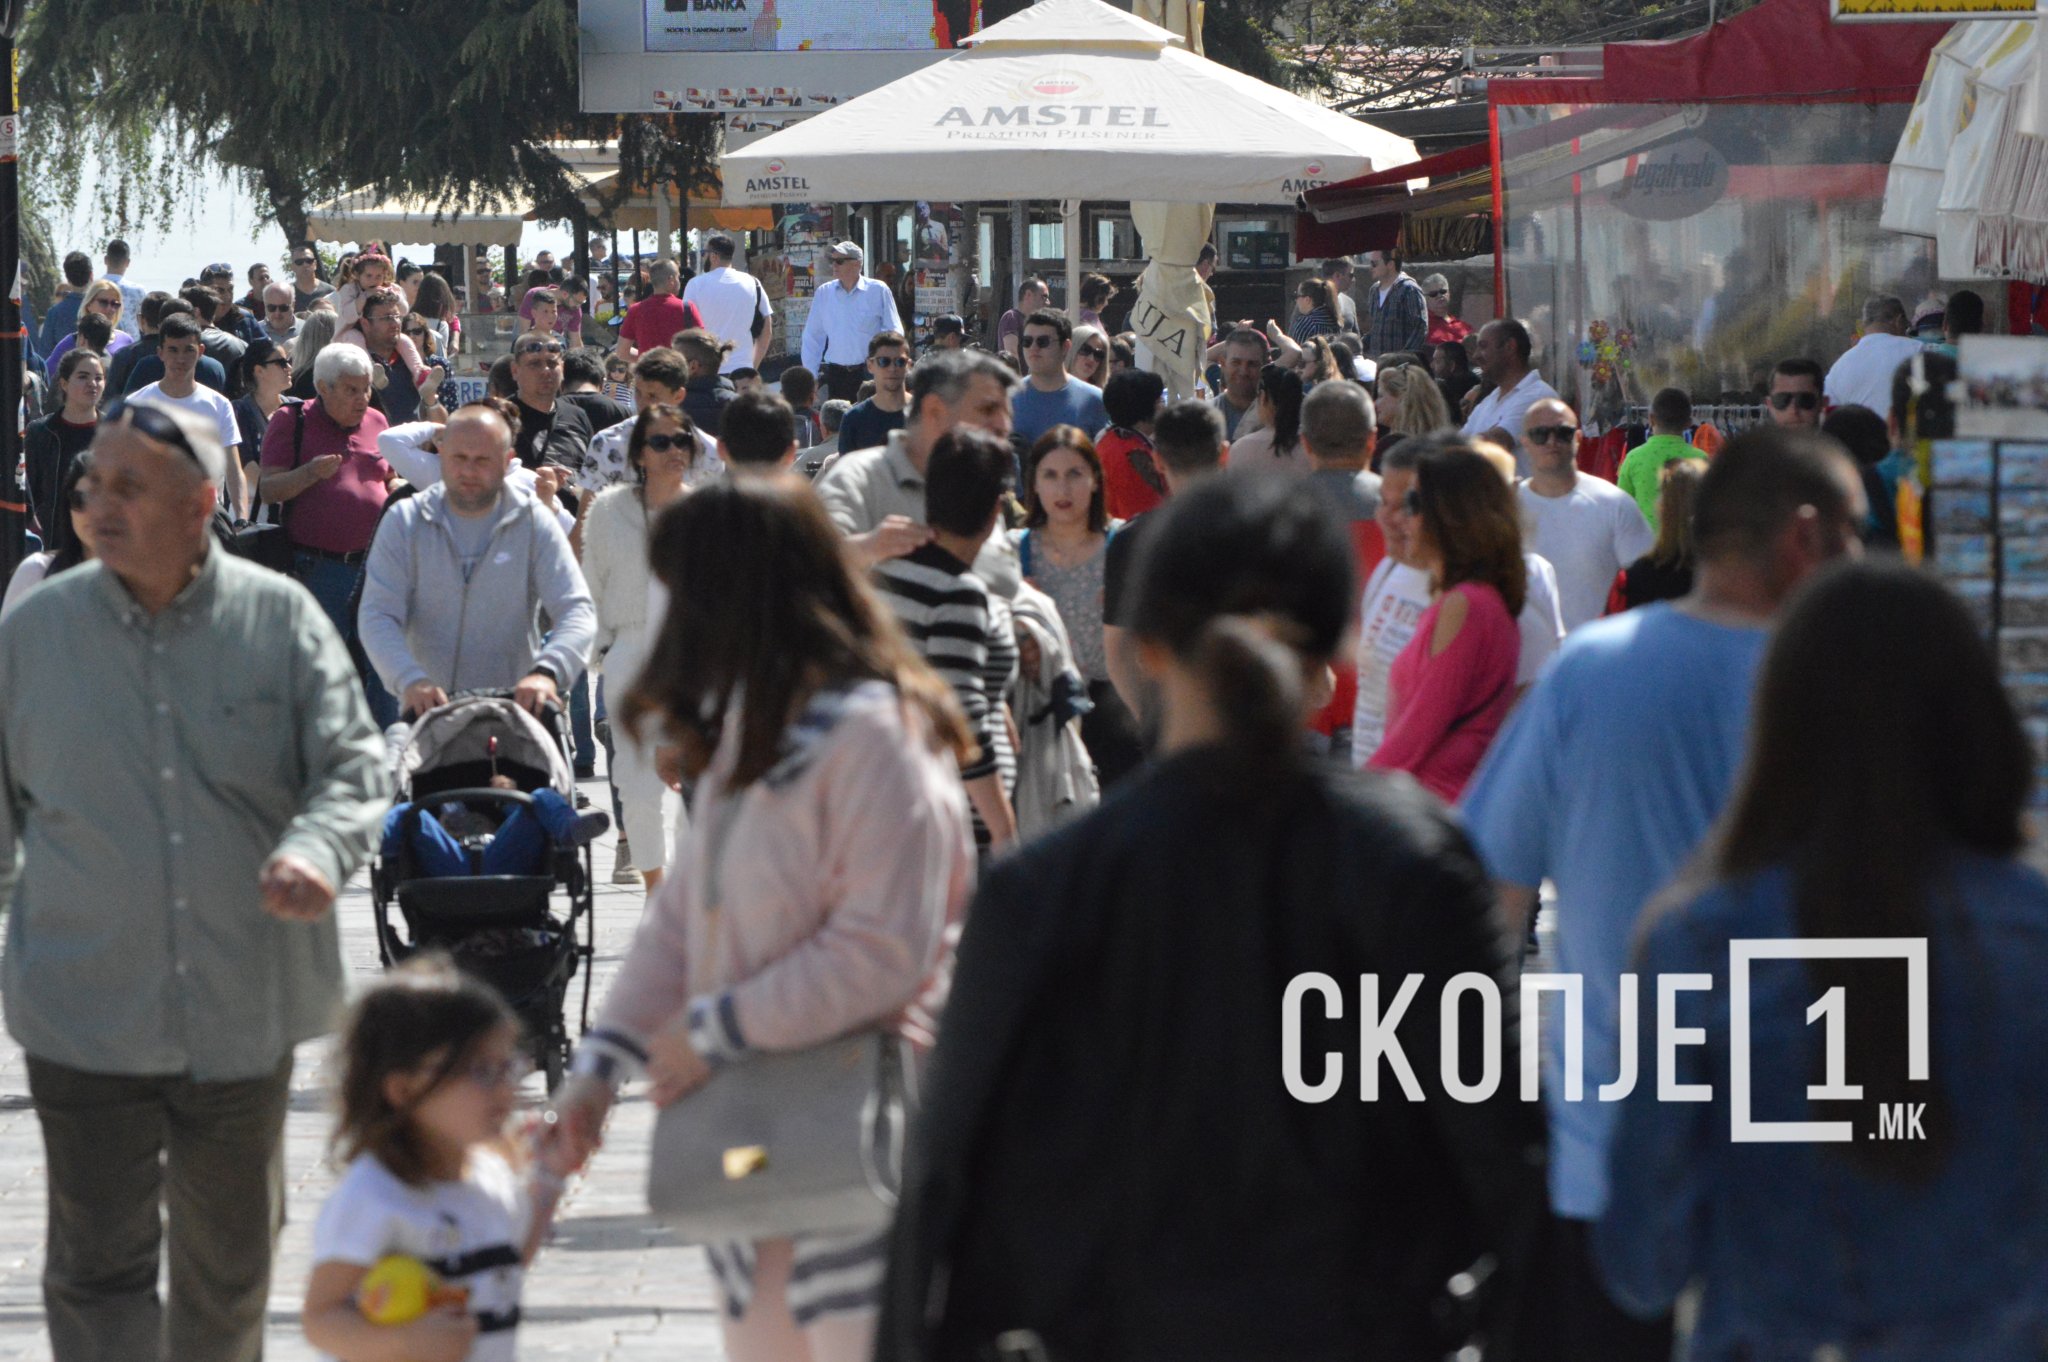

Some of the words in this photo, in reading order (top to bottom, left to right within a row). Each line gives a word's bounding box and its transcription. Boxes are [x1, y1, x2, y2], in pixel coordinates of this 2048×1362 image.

[934, 105, 1170, 127] AMSTEL
[745, 176, 811, 192] AMSTEL
[1281, 179, 1335, 192] AMST
[1137, 301, 1183, 358] IJA
